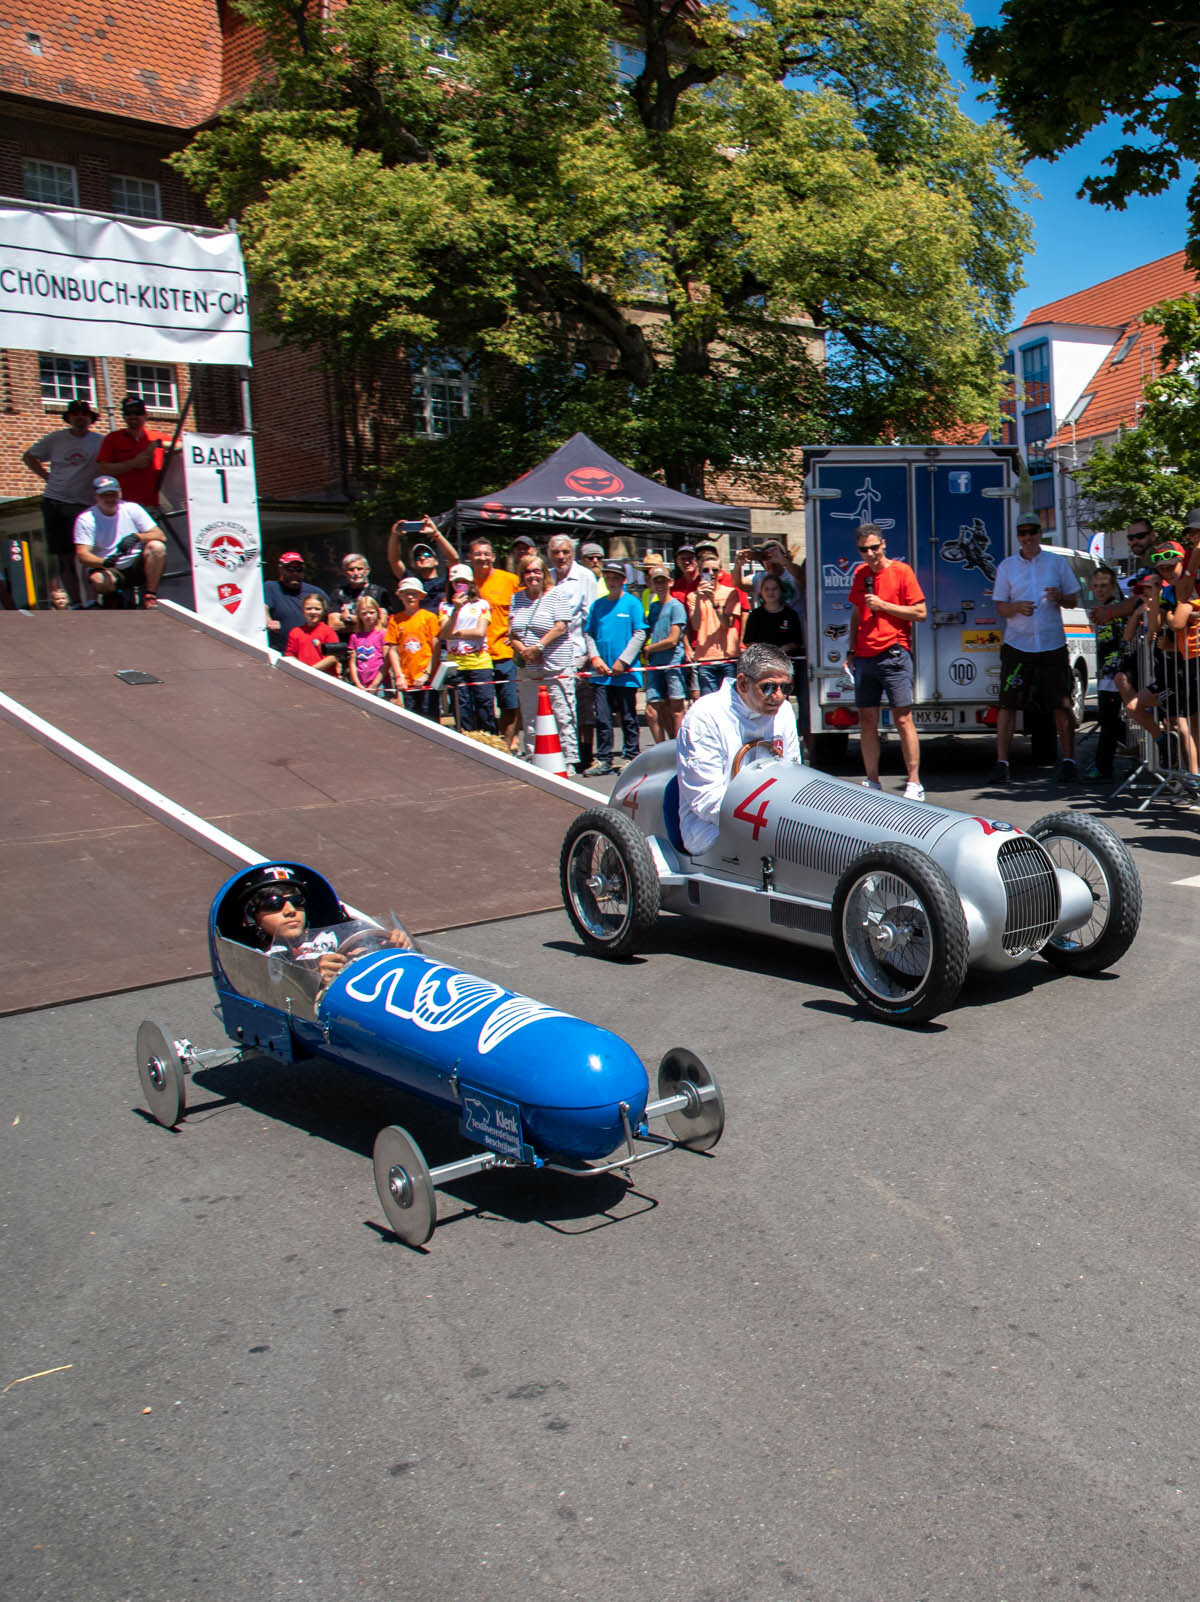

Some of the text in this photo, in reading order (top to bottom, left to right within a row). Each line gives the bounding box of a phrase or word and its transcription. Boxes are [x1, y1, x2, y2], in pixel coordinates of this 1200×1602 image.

[191, 445, 247, 467] BAHN
[215, 468, 229, 504] 1
[510, 507, 597, 522] 24MX
[951, 663, 974, 681] 100
[916, 712, 949, 722] MX 94
[622, 773, 648, 820] 4
[733, 777, 778, 841] 4
[496, 1110, 519, 1134] Klenk
